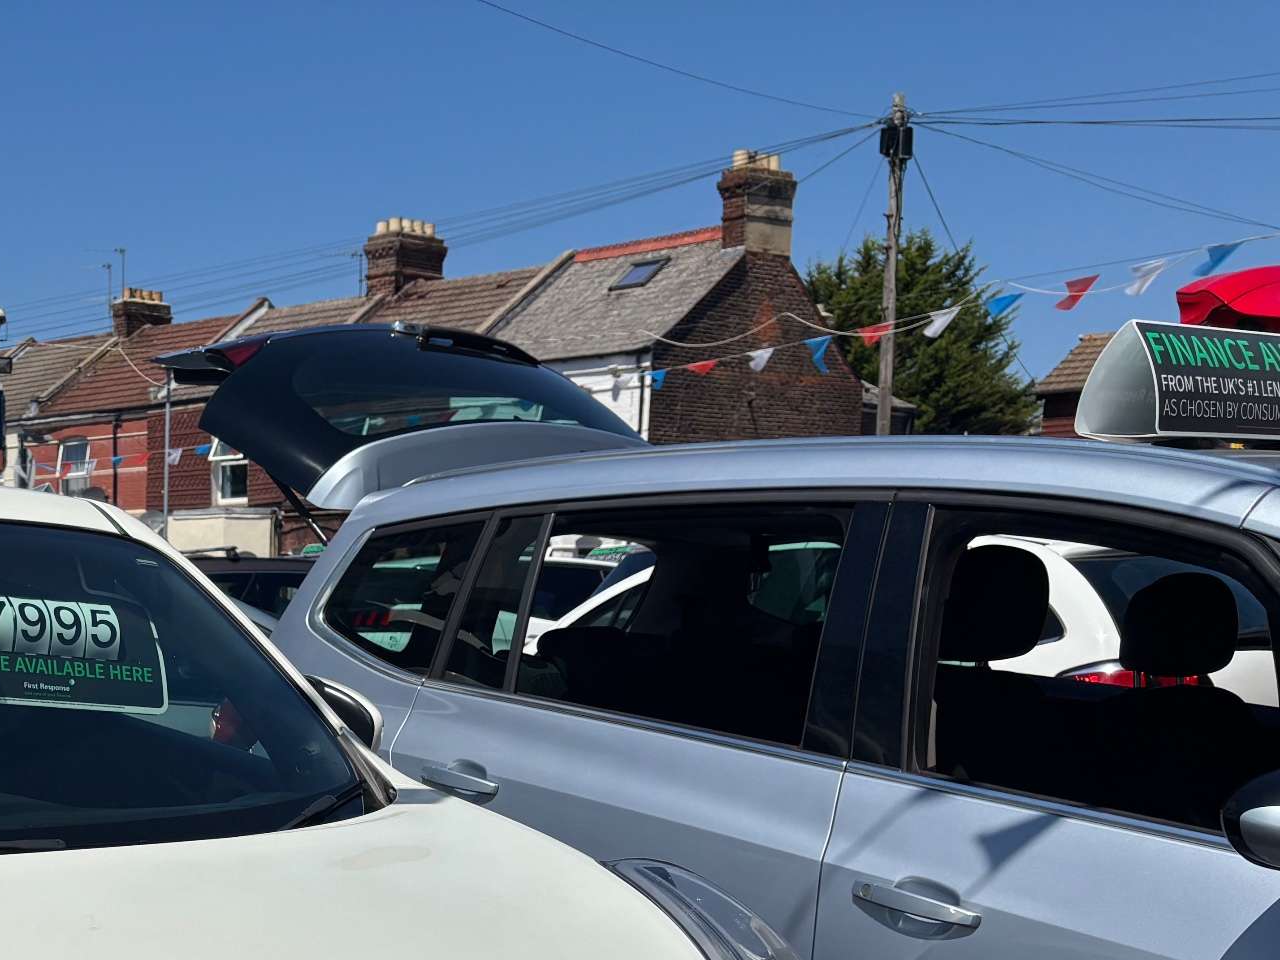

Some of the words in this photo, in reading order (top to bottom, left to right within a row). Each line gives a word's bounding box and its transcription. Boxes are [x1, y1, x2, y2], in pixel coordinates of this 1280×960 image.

[1145, 331, 1260, 371] FINANCE
[1161, 374, 1194, 392] FROM
[1195, 376, 1219, 394] THE
[1220, 377, 1246, 396] UK'S
[1247, 379, 1259, 396] #1
[1163, 399, 1178, 417] AS
[1180, 399, 1224, 419] CHOSEN
[1227, 401, 1238, 419] BY
[15, 655, 106, 680] AVAILABLE
[109, 663, 153, 684] HERE
